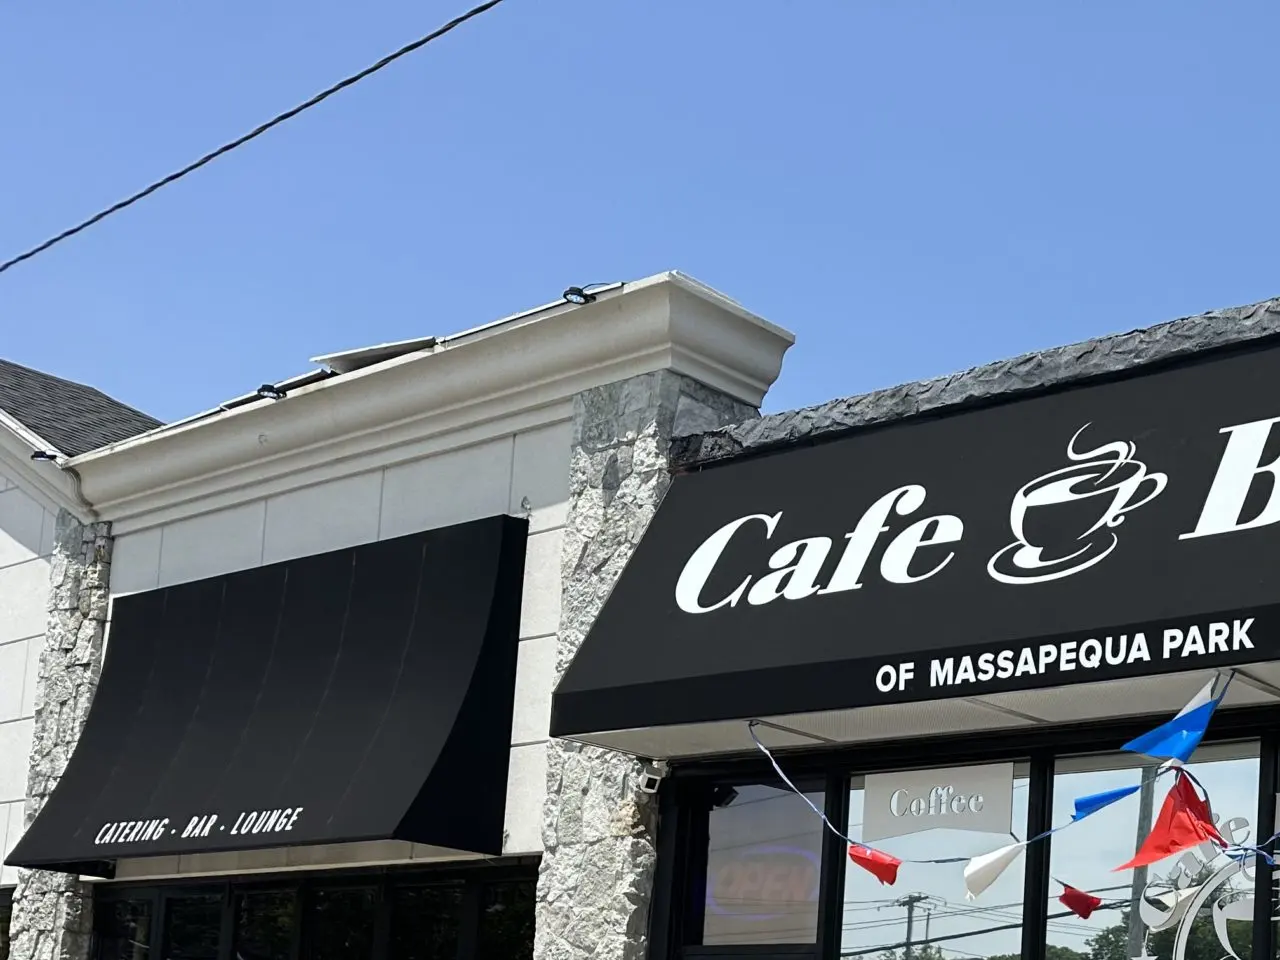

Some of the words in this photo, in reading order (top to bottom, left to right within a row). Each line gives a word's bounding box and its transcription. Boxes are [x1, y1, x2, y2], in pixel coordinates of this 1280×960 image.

[674, 484, 965, 614] Cafe
[875, 663, 915, 693] OF
[929, 632, 1151, 688] MASSAPEQUA
[1162, 618, 1256, 660] PARK
[94, 818, 170, 845] CATERING
[181, 814, 218, 838] BAR
[230, 807, 304, 835] LOUNGE
[889, 785, 984, 818] Coffee
